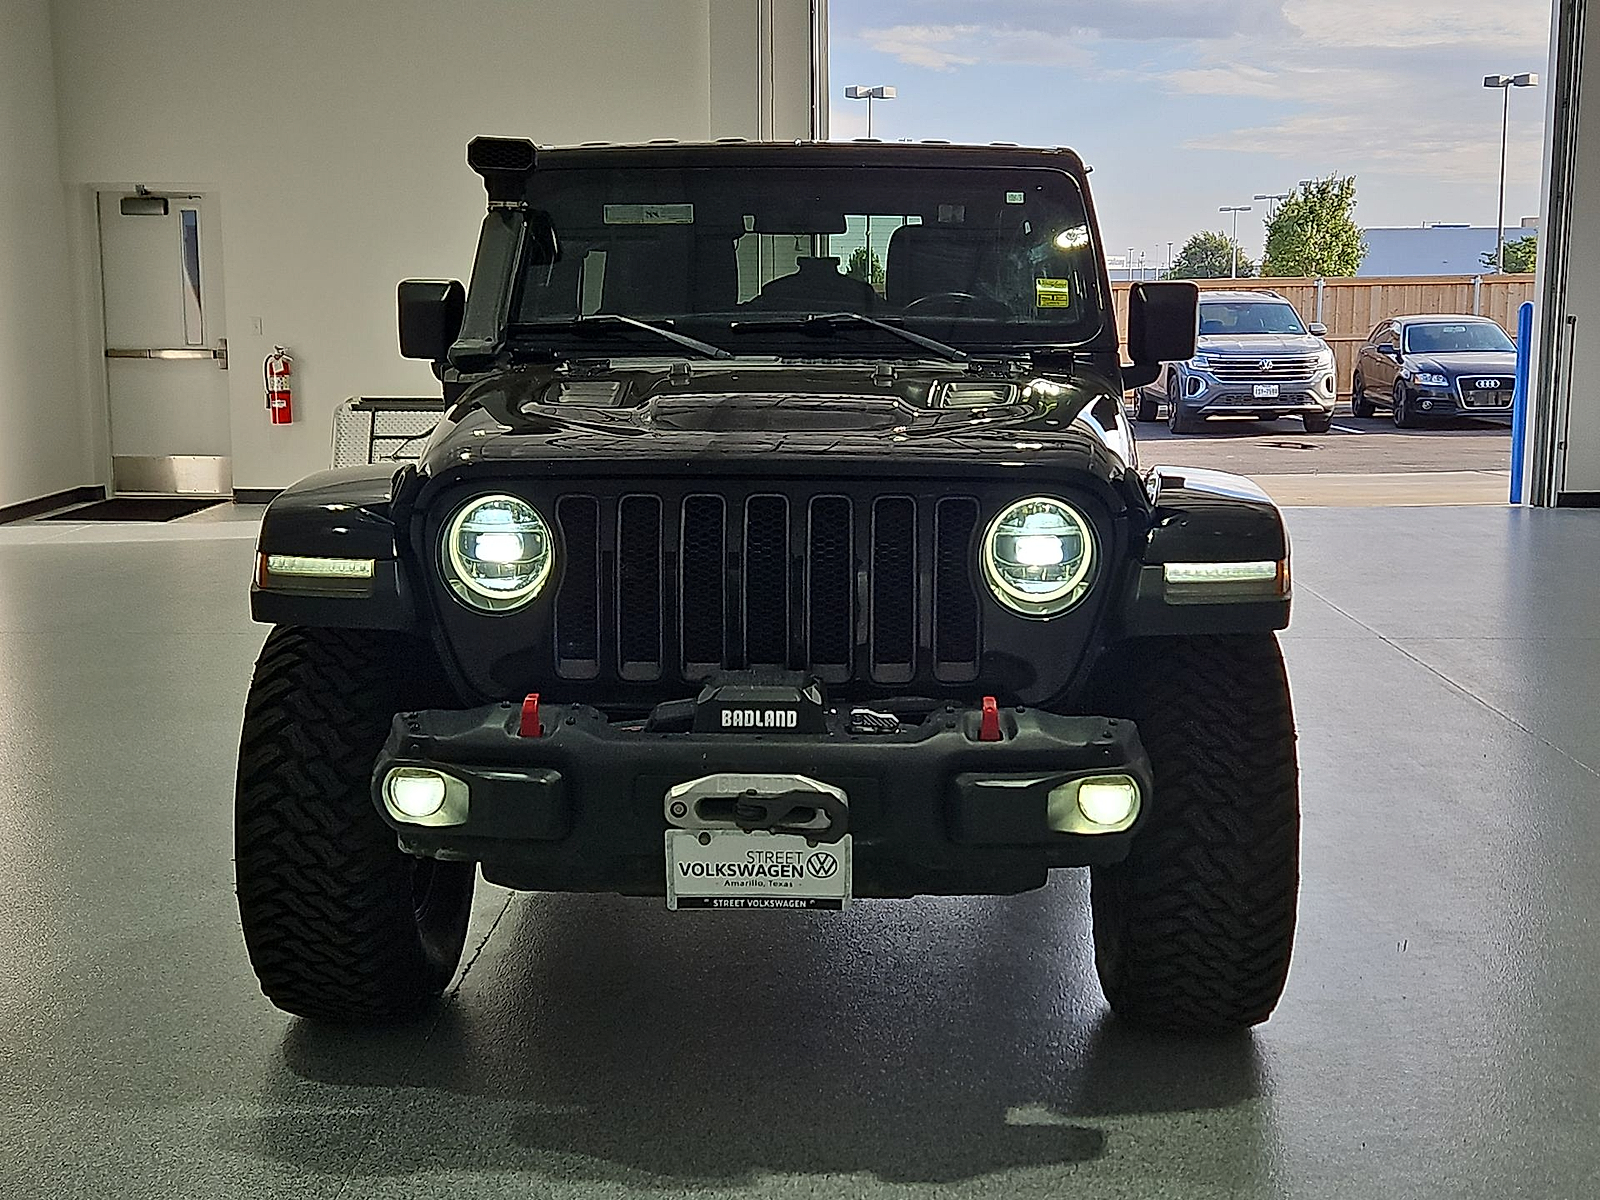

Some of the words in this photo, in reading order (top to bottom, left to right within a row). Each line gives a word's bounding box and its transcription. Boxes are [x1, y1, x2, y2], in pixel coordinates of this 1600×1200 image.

[722, 710, 797, 727] BADLAND
[746, 851, 803, 864] STREET
[678, 863, 804, 878] VOLKSWAGEN
[724, 879, 766, 888] Amarillo,
[768, 880, 793, 888] Texas
[713, 899, 745, 908] STREET
[747, 899, 807, 908] VOLKSWAGEN
